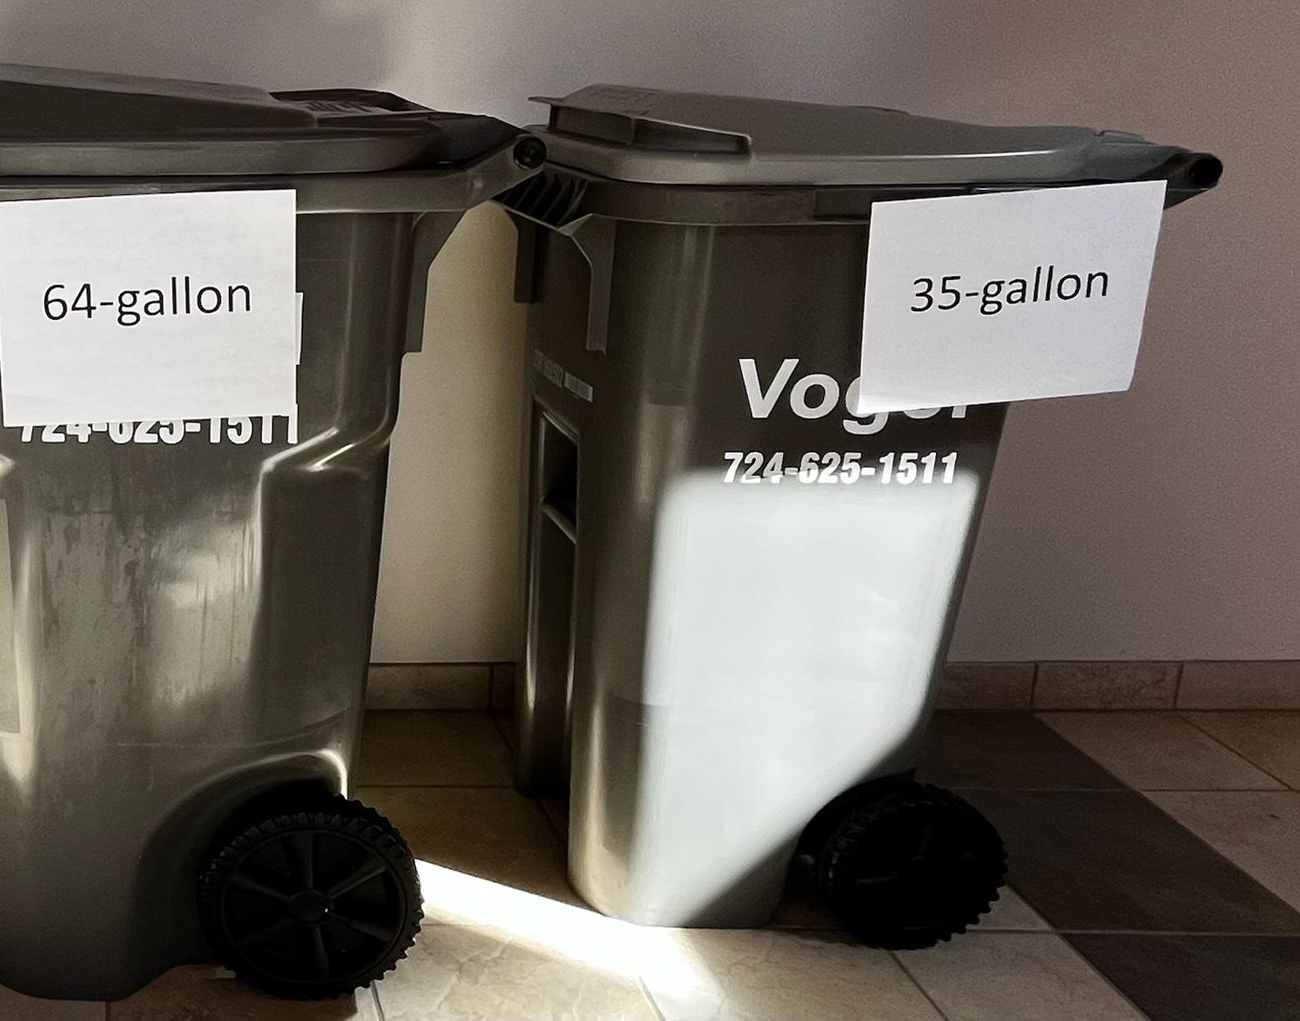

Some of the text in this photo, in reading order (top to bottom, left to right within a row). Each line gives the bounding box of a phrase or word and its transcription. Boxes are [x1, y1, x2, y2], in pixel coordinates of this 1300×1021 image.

[43, 276, 252, 326] 64-gallon
[909, 265, 1110, 316] 35-gallon
[723, 451, 958, 484] 724-625-1511
